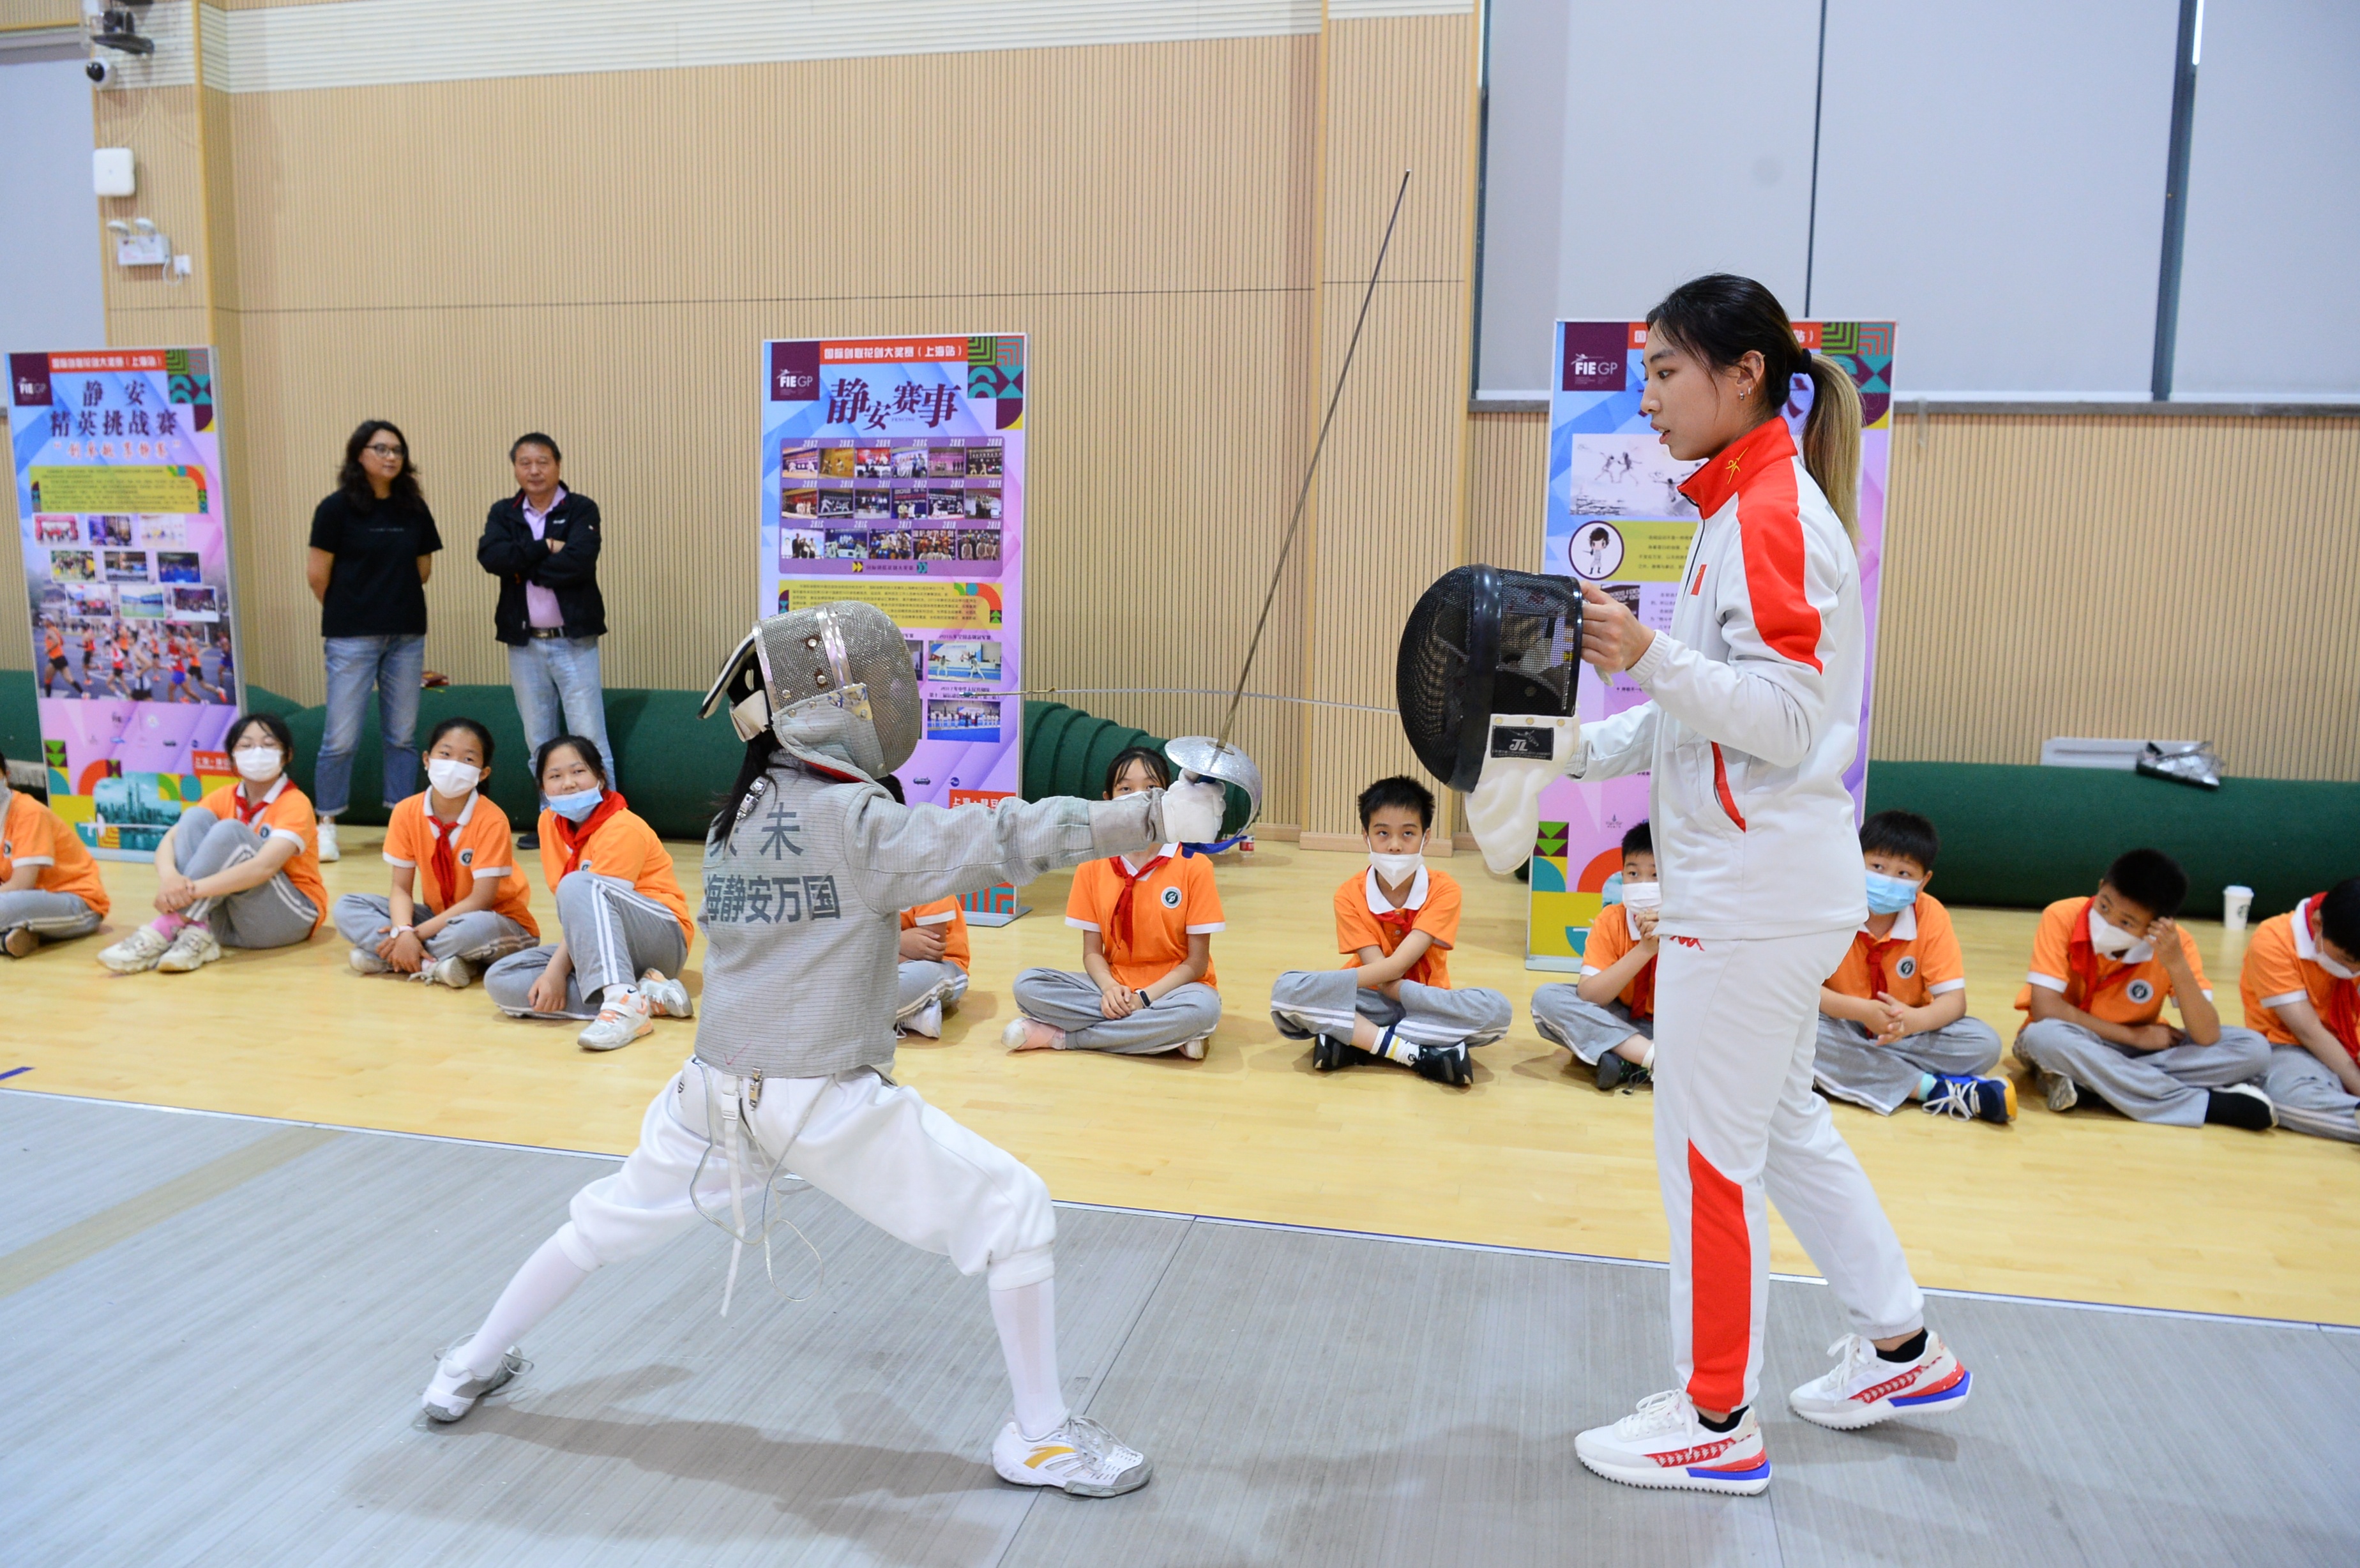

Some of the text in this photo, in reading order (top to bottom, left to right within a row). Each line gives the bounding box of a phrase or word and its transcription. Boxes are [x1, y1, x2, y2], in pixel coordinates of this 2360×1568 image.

[780, 375, 813, 388] FIE GP
[1575, 361, 1618, 375] FIE GP
[83, 379, 146, 407] 静安
[826, 377, 962, 430] 静安赛事
[50, 409, 178, 437] 精英挑战赛
[1509, 739, 1528, 751] JL
[697, 873, 841, 924] 海静安万国
